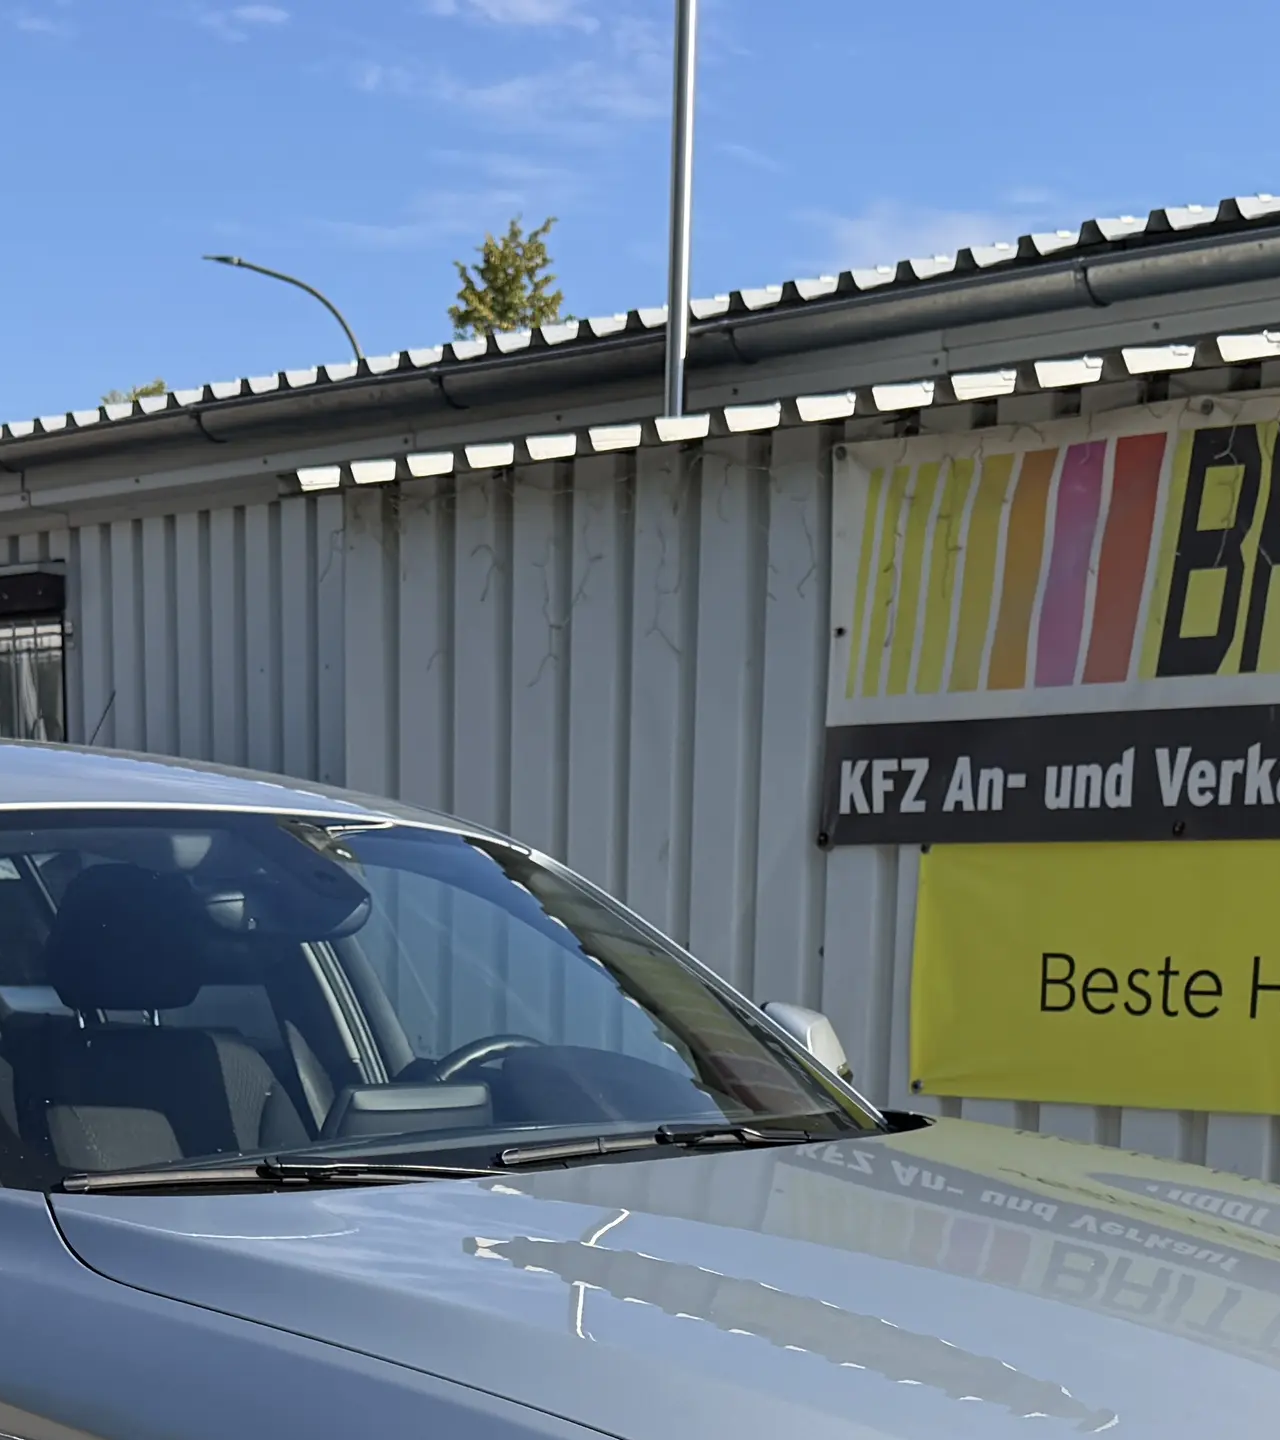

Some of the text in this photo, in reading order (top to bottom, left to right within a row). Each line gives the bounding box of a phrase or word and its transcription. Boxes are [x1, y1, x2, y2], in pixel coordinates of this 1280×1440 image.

[838, 757, 930, 815] KFZ
[942, 756, 1027, 813] An-
[1044, 745, 1135, 810] und
[1040, 952, 1224, 1018] Beste
